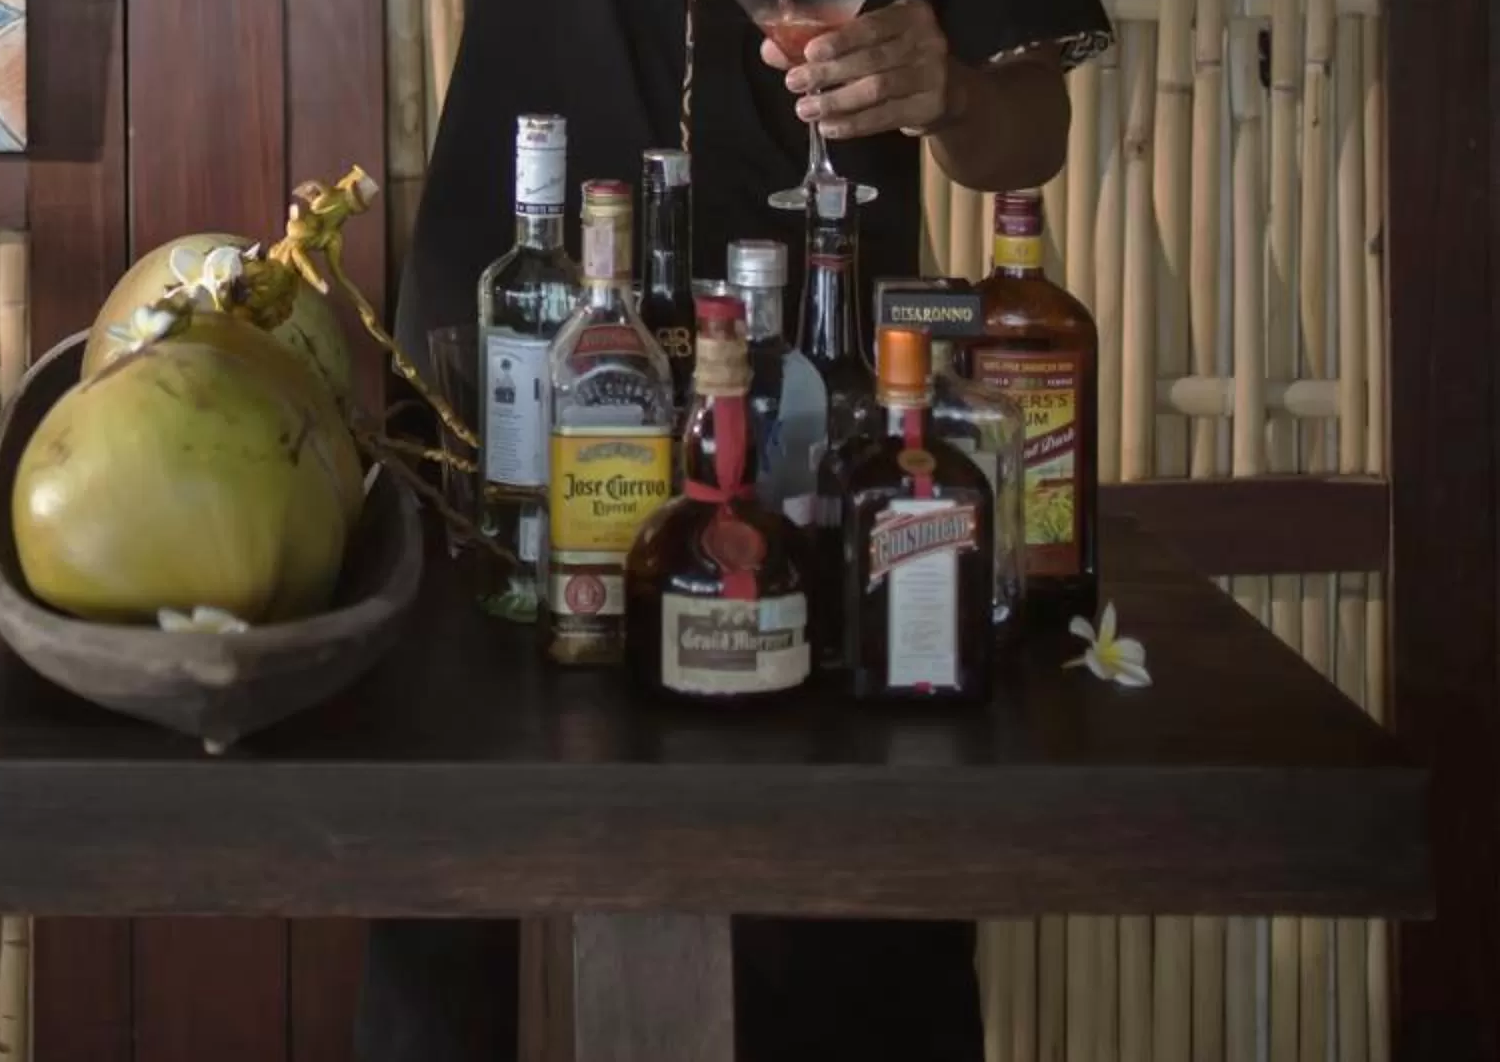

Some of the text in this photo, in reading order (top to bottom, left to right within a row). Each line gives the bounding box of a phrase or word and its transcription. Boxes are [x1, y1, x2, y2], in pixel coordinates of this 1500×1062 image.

[891, 306, 973, 323] DISARONNO
[564, 473, 666, 500] Jose Cuervo
